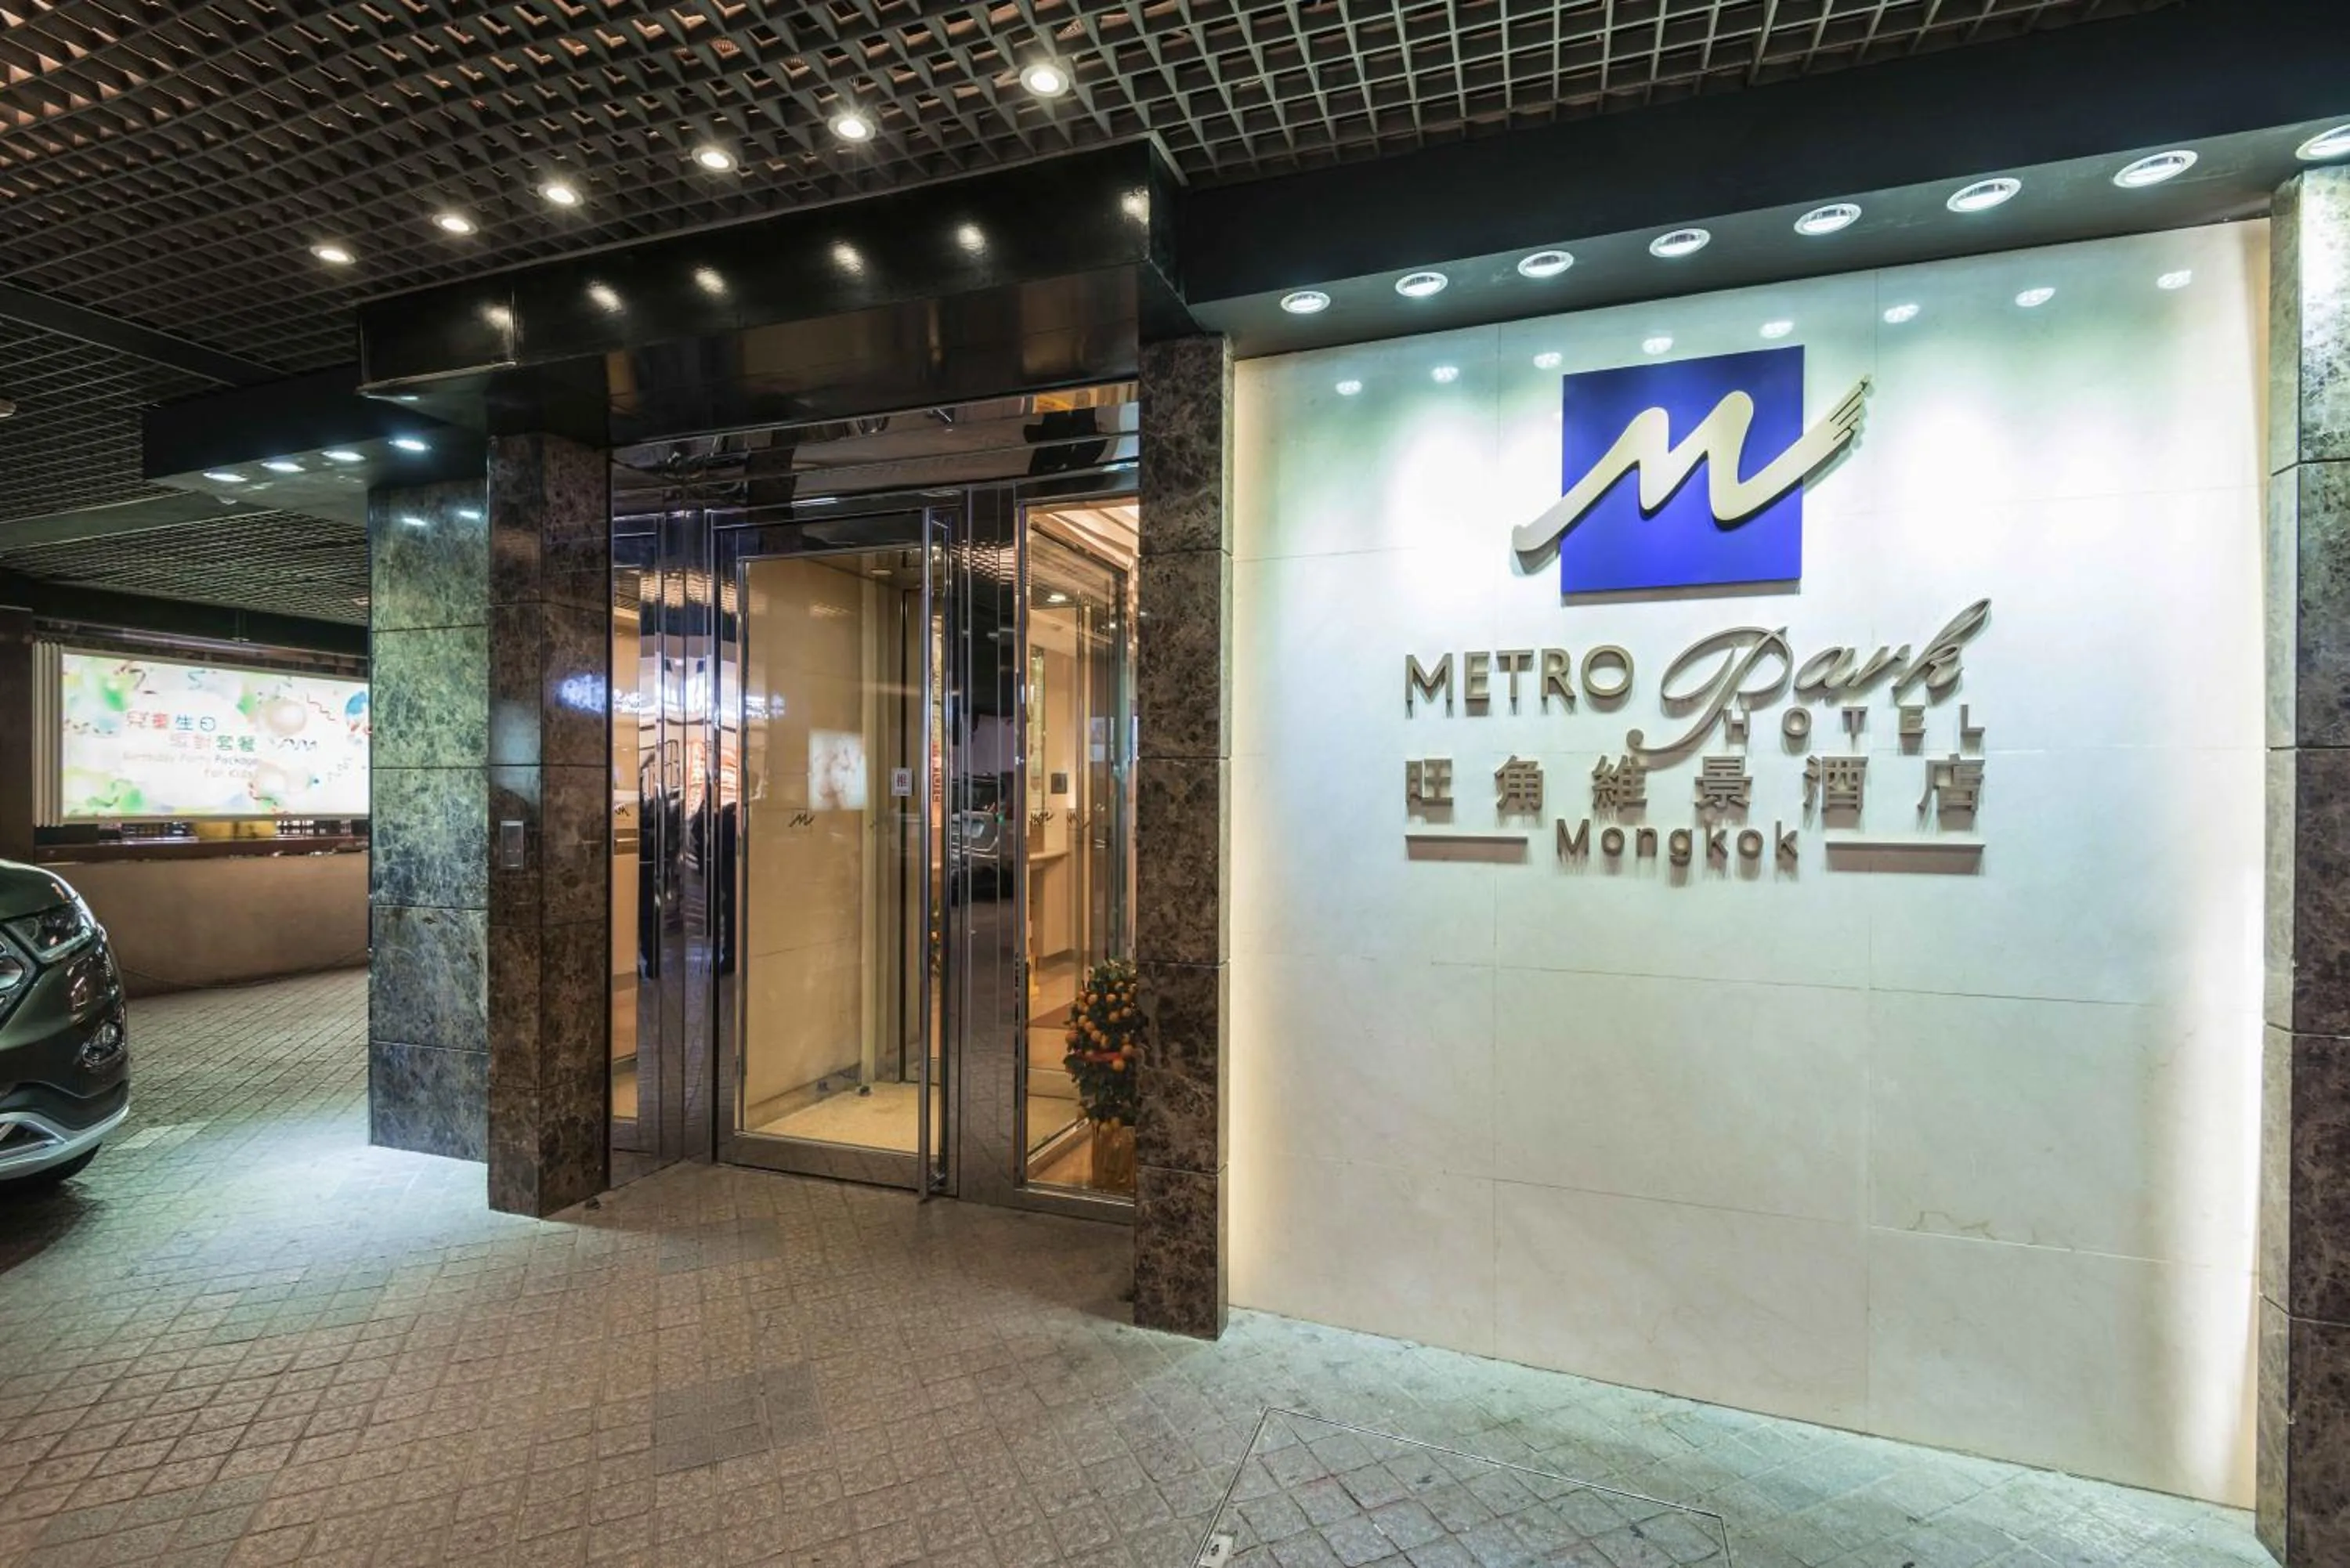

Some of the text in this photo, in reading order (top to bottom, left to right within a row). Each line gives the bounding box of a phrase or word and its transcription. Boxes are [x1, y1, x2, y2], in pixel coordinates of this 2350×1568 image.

[1405, 598, 1992, 754] METRO Park
[1723, 703, 1986, 738] HOTEL
[1405, 753, 1986, 814] 旺角維景酒店
[1556, 818, 1799, 866] Mongkok
